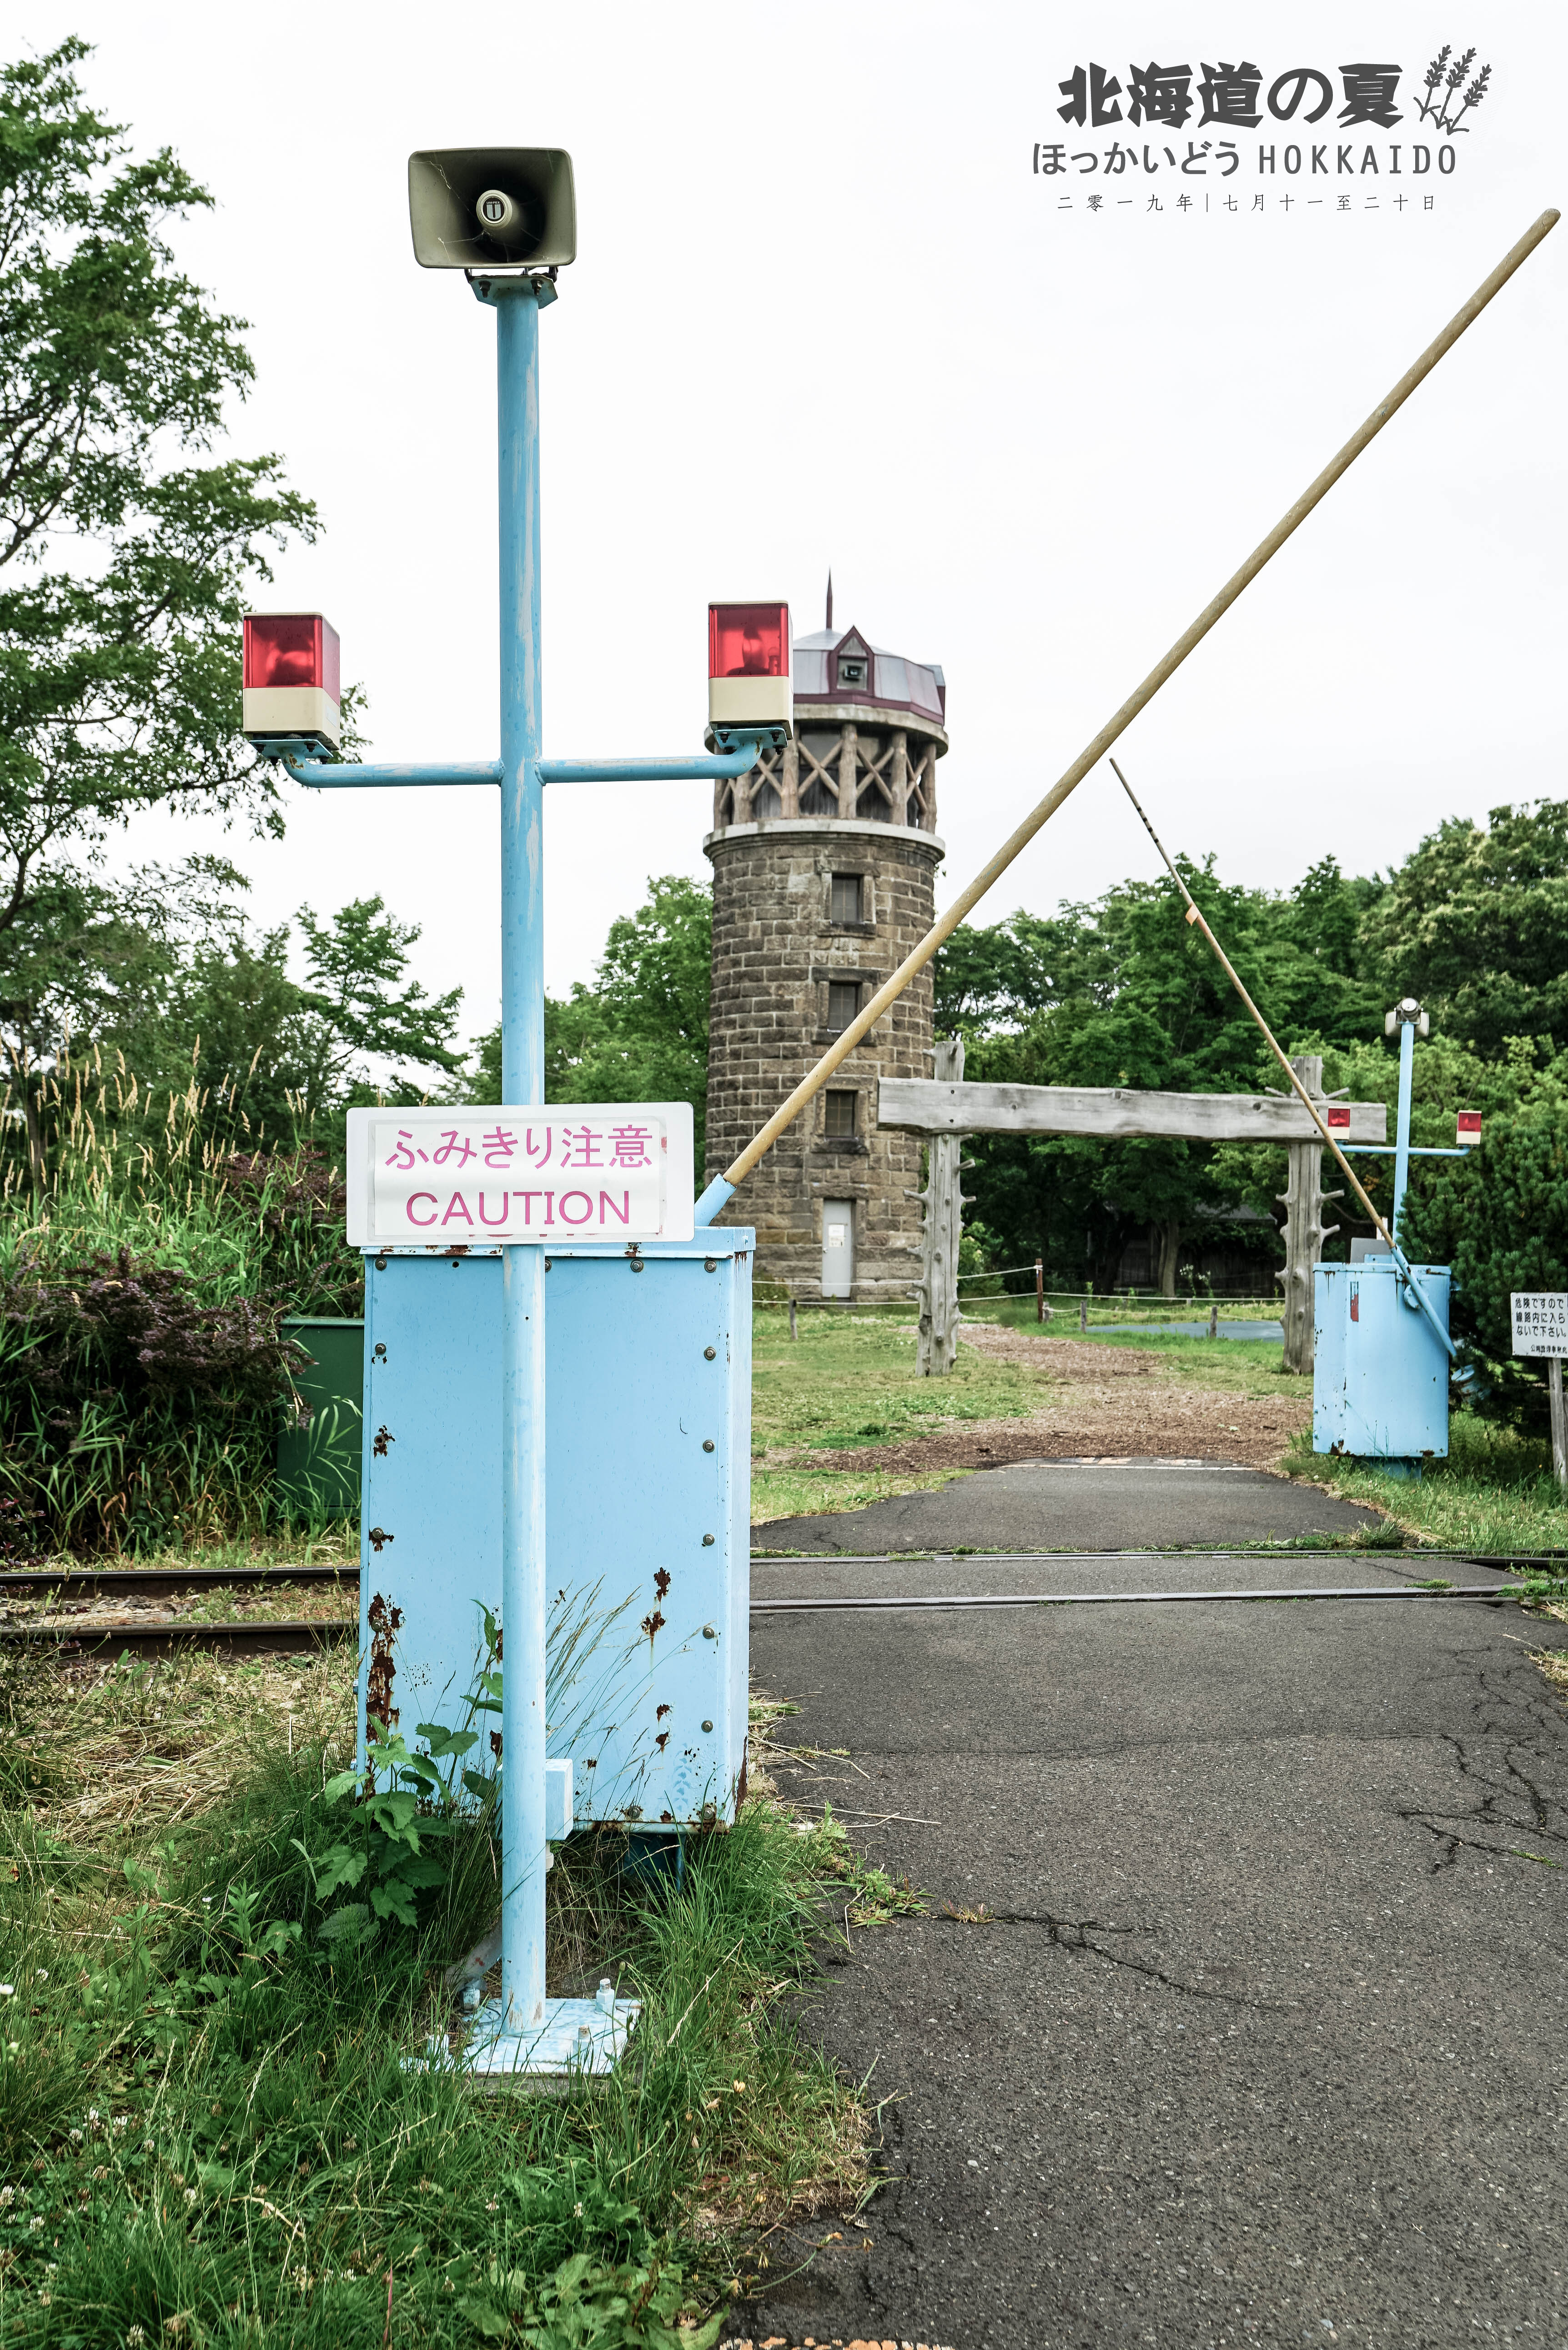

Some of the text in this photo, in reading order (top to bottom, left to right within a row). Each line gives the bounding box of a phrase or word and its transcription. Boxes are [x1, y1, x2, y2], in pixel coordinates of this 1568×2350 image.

[385, 1125, 652, 1170] ふみきり注意
[406, 1191, 629, 1226] CAUTION
